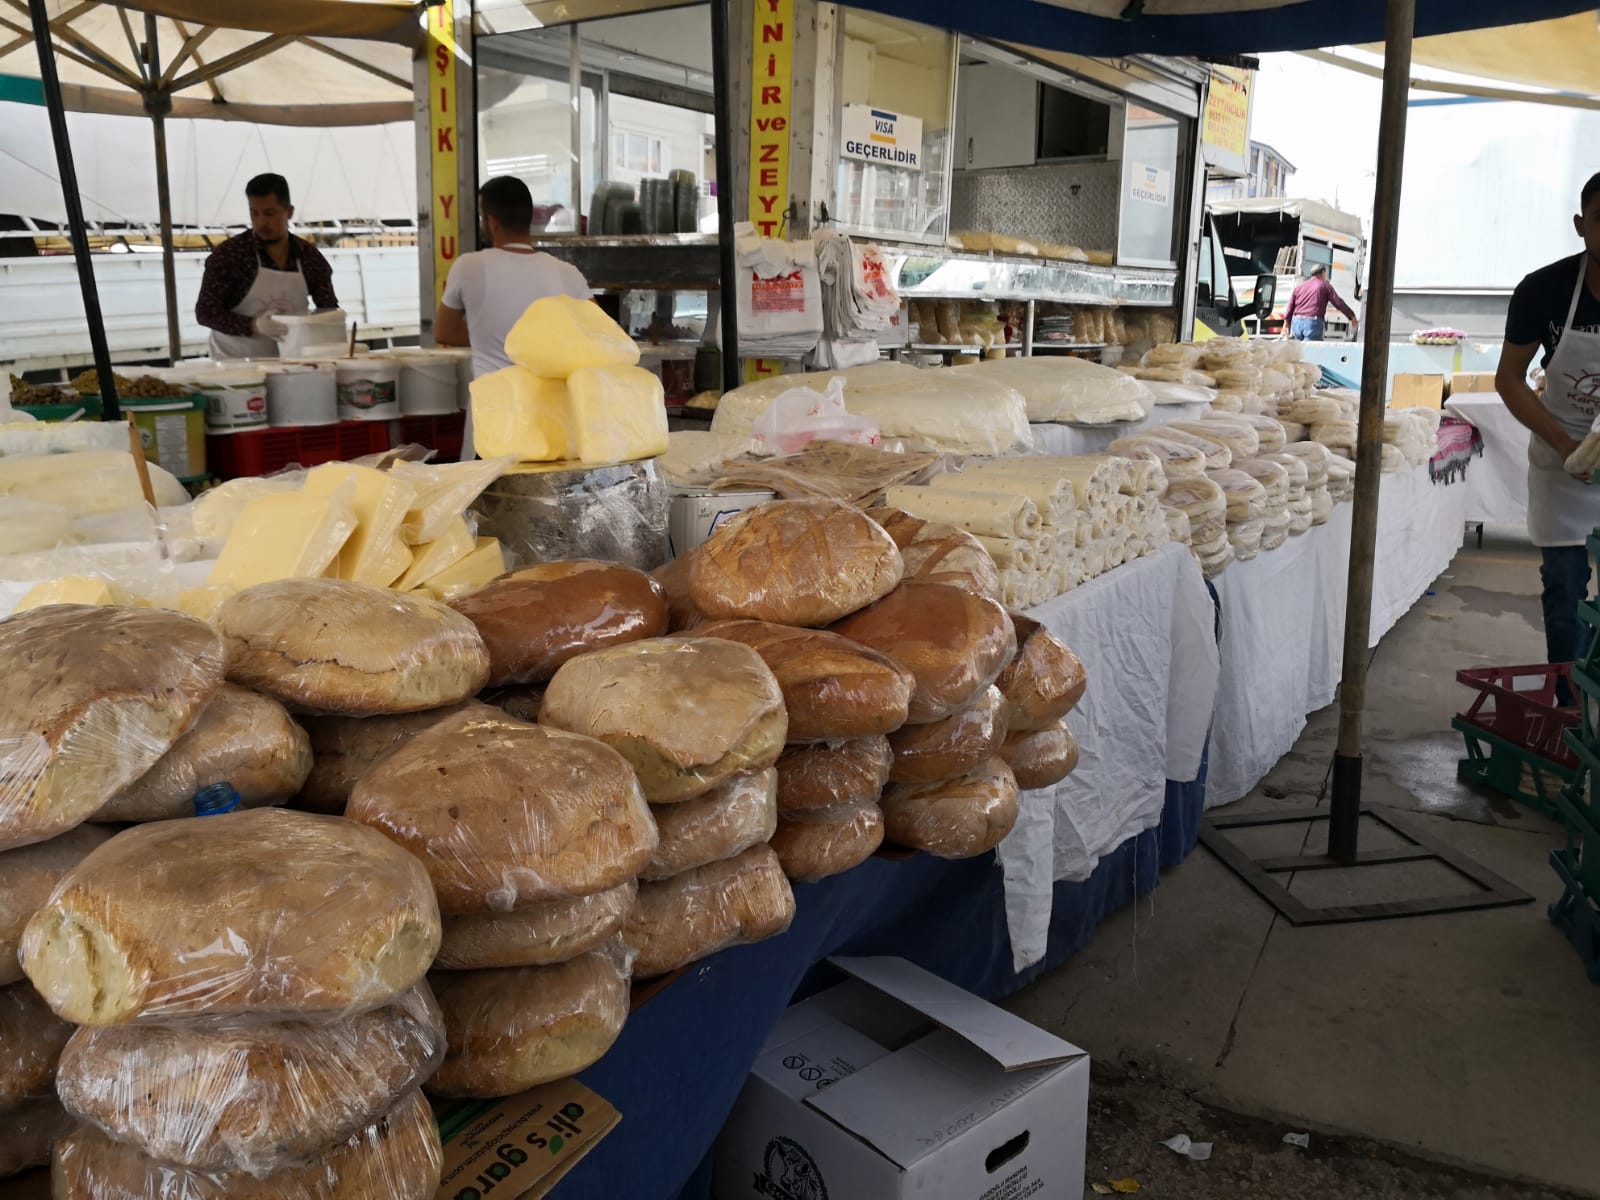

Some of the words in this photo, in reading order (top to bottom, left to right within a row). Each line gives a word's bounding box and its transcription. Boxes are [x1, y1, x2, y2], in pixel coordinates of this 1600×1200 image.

[756, 116, 787, 132] ve
[875, 119, 894, 135] VISA
[846, 140, 917, 166] GEÇERLİDİR
